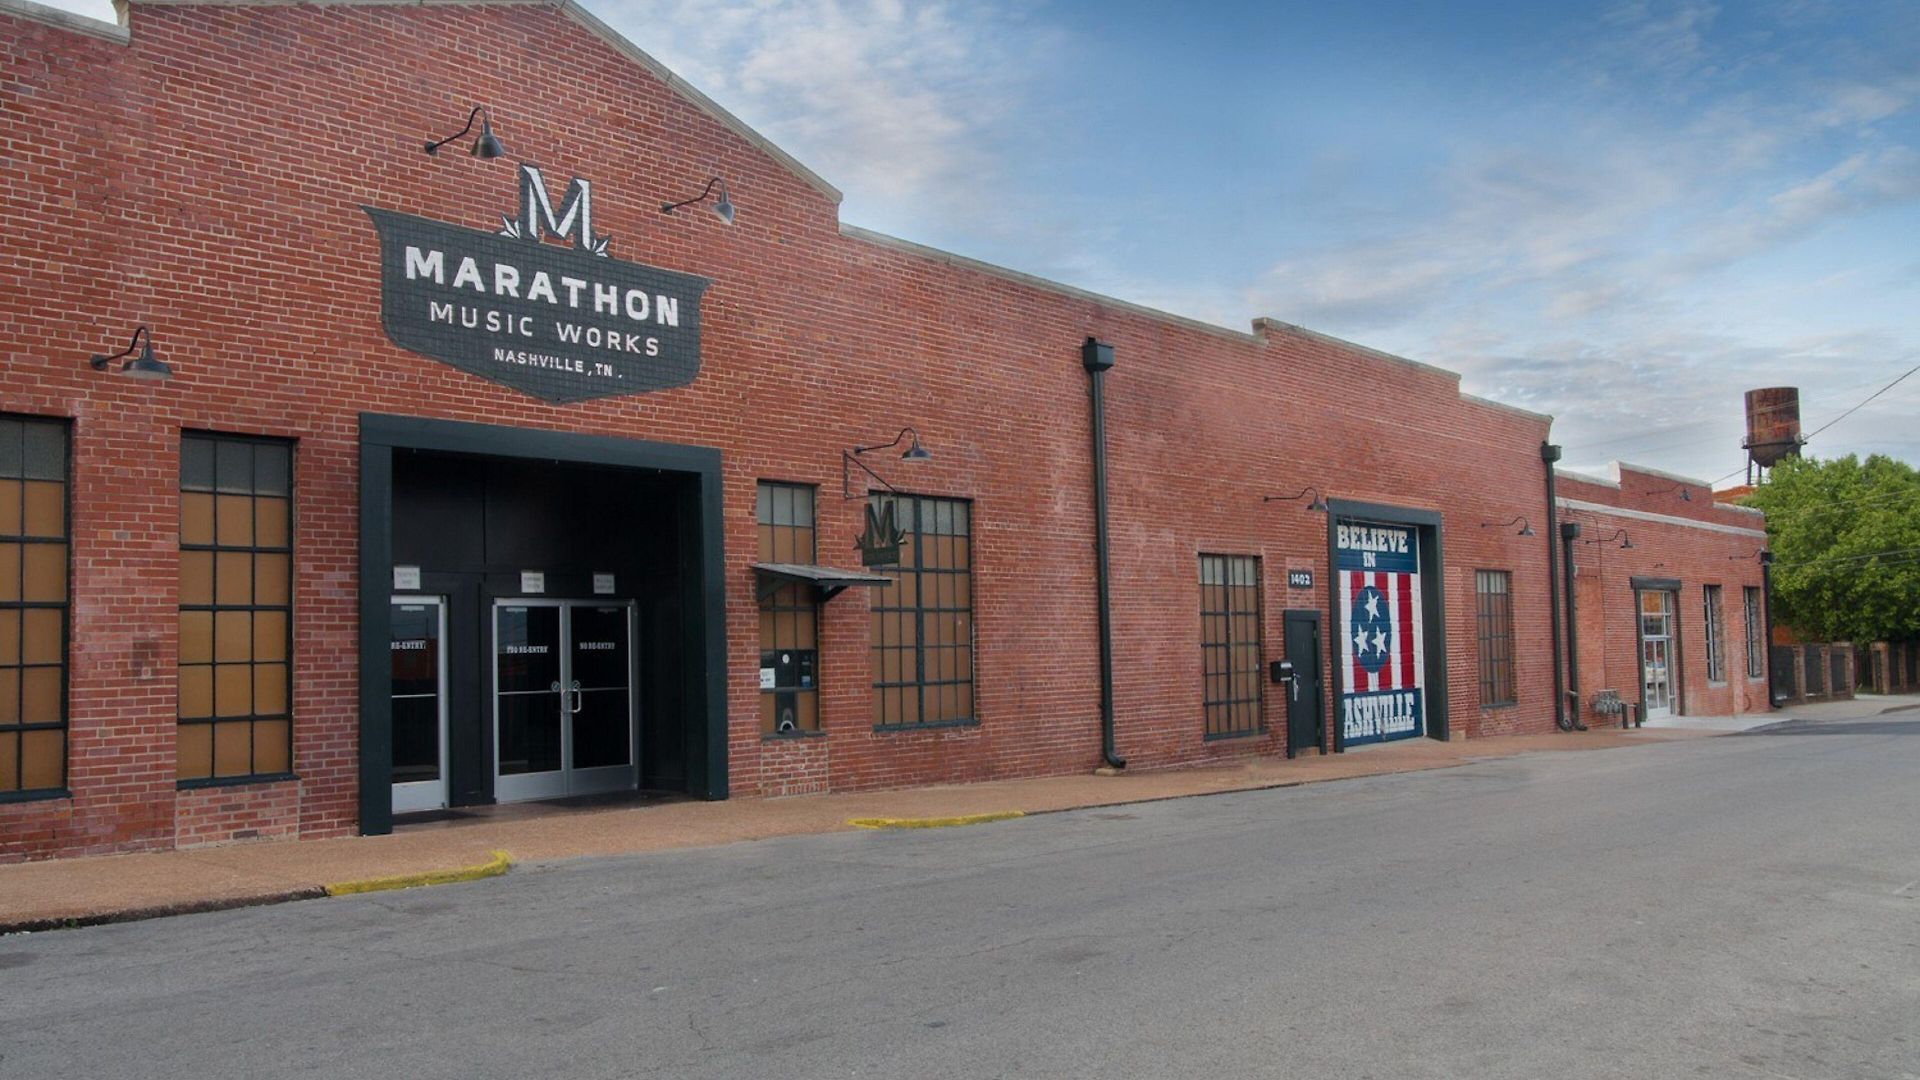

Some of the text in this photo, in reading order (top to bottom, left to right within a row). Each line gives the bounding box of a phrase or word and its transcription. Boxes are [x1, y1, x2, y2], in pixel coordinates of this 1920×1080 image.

[405, 246, 680, 327] MARATHON
[430, 301, 660, 357] MUSIC WORKS
[1337, 525, 1408, 553] BELIEVE
[1363, 551, 1376, 568] IN
[1291, 573, 1311, 585] 1402
[1343, 692, 1415, 739] ASHVILLE
